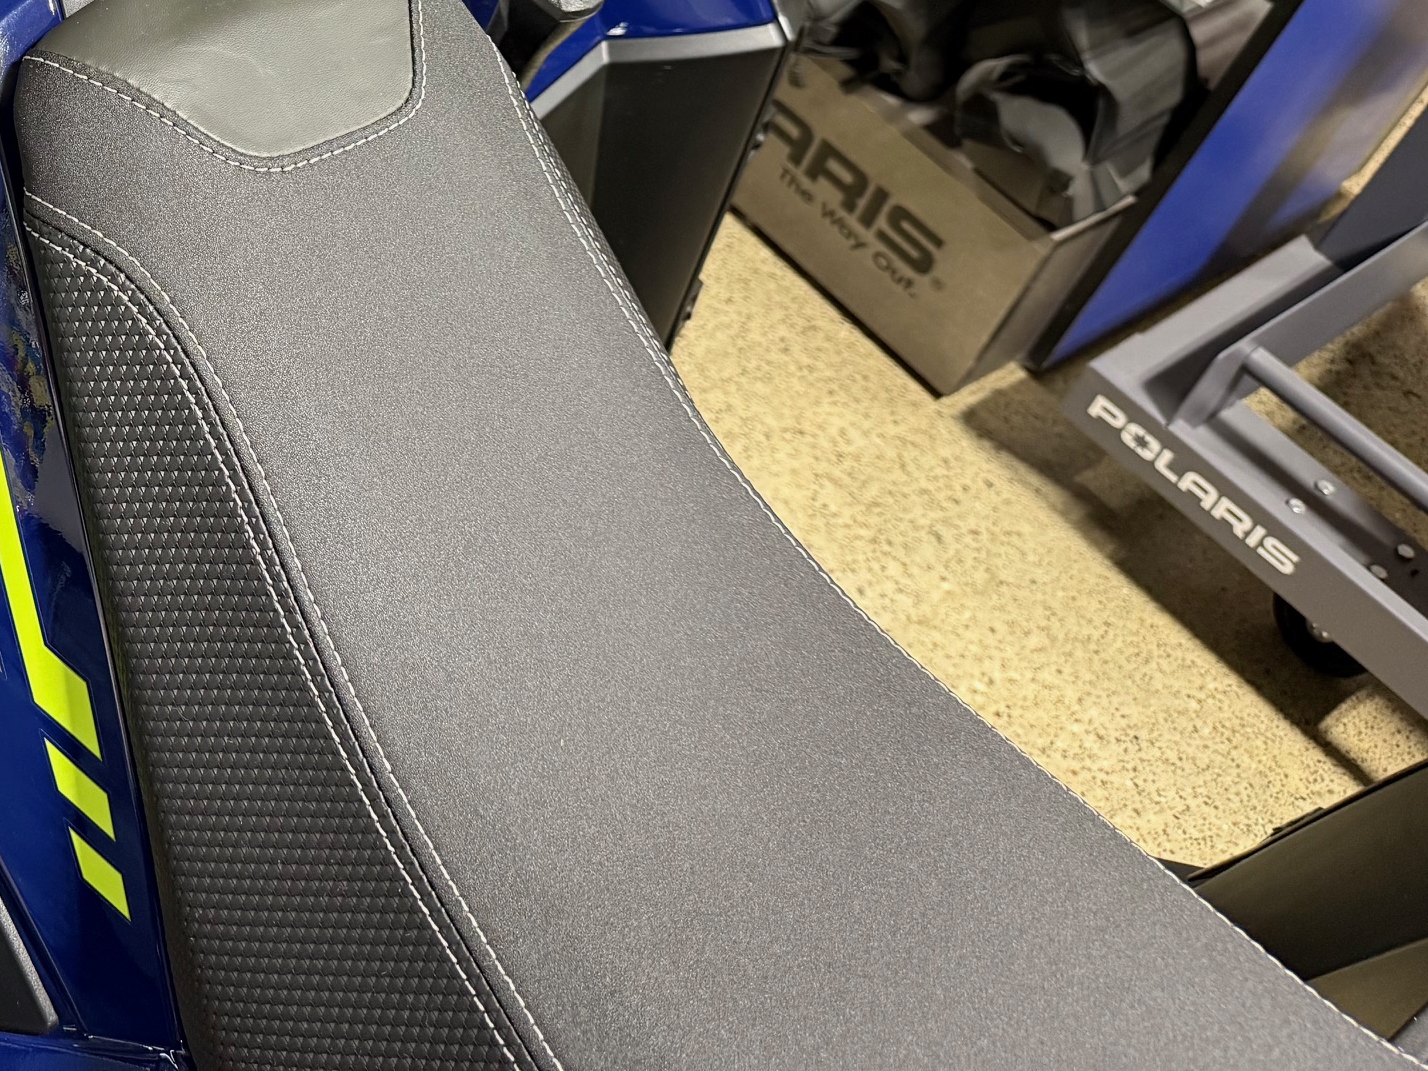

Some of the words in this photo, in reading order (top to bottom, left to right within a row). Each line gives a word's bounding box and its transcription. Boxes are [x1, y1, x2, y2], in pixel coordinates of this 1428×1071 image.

[779, 167, 814, 205] The
[821, 202, 868, 253] Way
[1087, 394, 1301, 575] POLARIS
